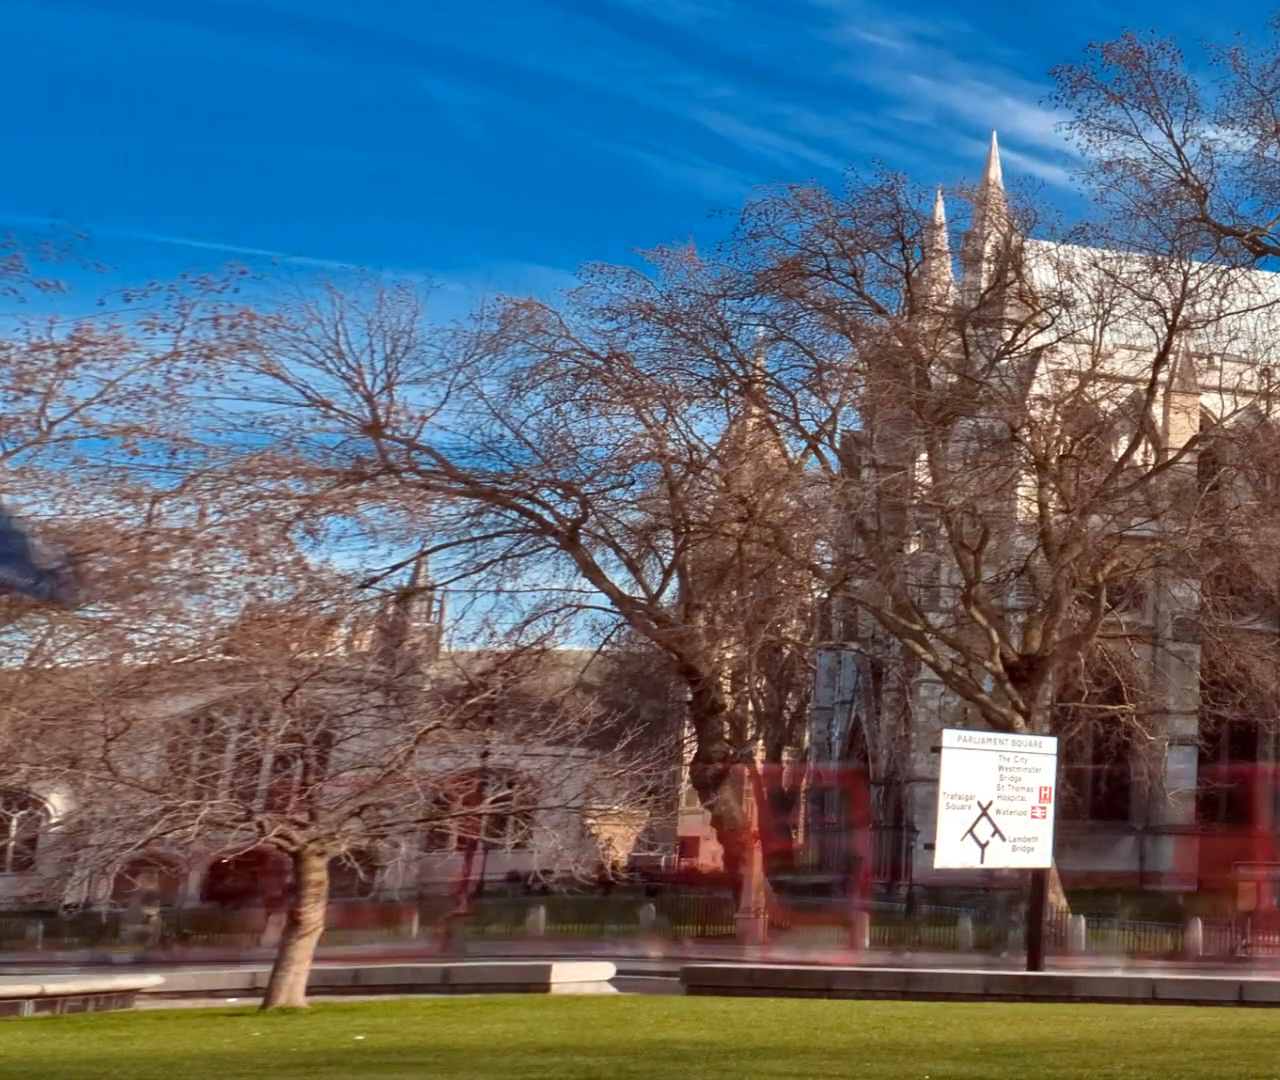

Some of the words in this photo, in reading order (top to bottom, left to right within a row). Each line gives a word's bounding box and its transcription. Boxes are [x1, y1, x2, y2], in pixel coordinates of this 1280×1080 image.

[957, 734, 1009, 746] PARLIAMENT
[1011, 739, 1043, 749] SQUARE
[998, 754, 1010, 763] The
[1013, 755, 1028, 765] City
[998, 764, 1042, 773] Westminster
[999, 774, 1022, 784] Bridge
[996, 783, 1005, 792] St
[943, 791, 976, 802] Trafalgar
[997, 793, 1027, 802] Hospital
[945, 802, 972, 811] Square
[995, 808, 1028, 817] Waterloo
[1008, 835, 1038, 844] Lambeth
[1011, 844, 1035, 854] Bridge
